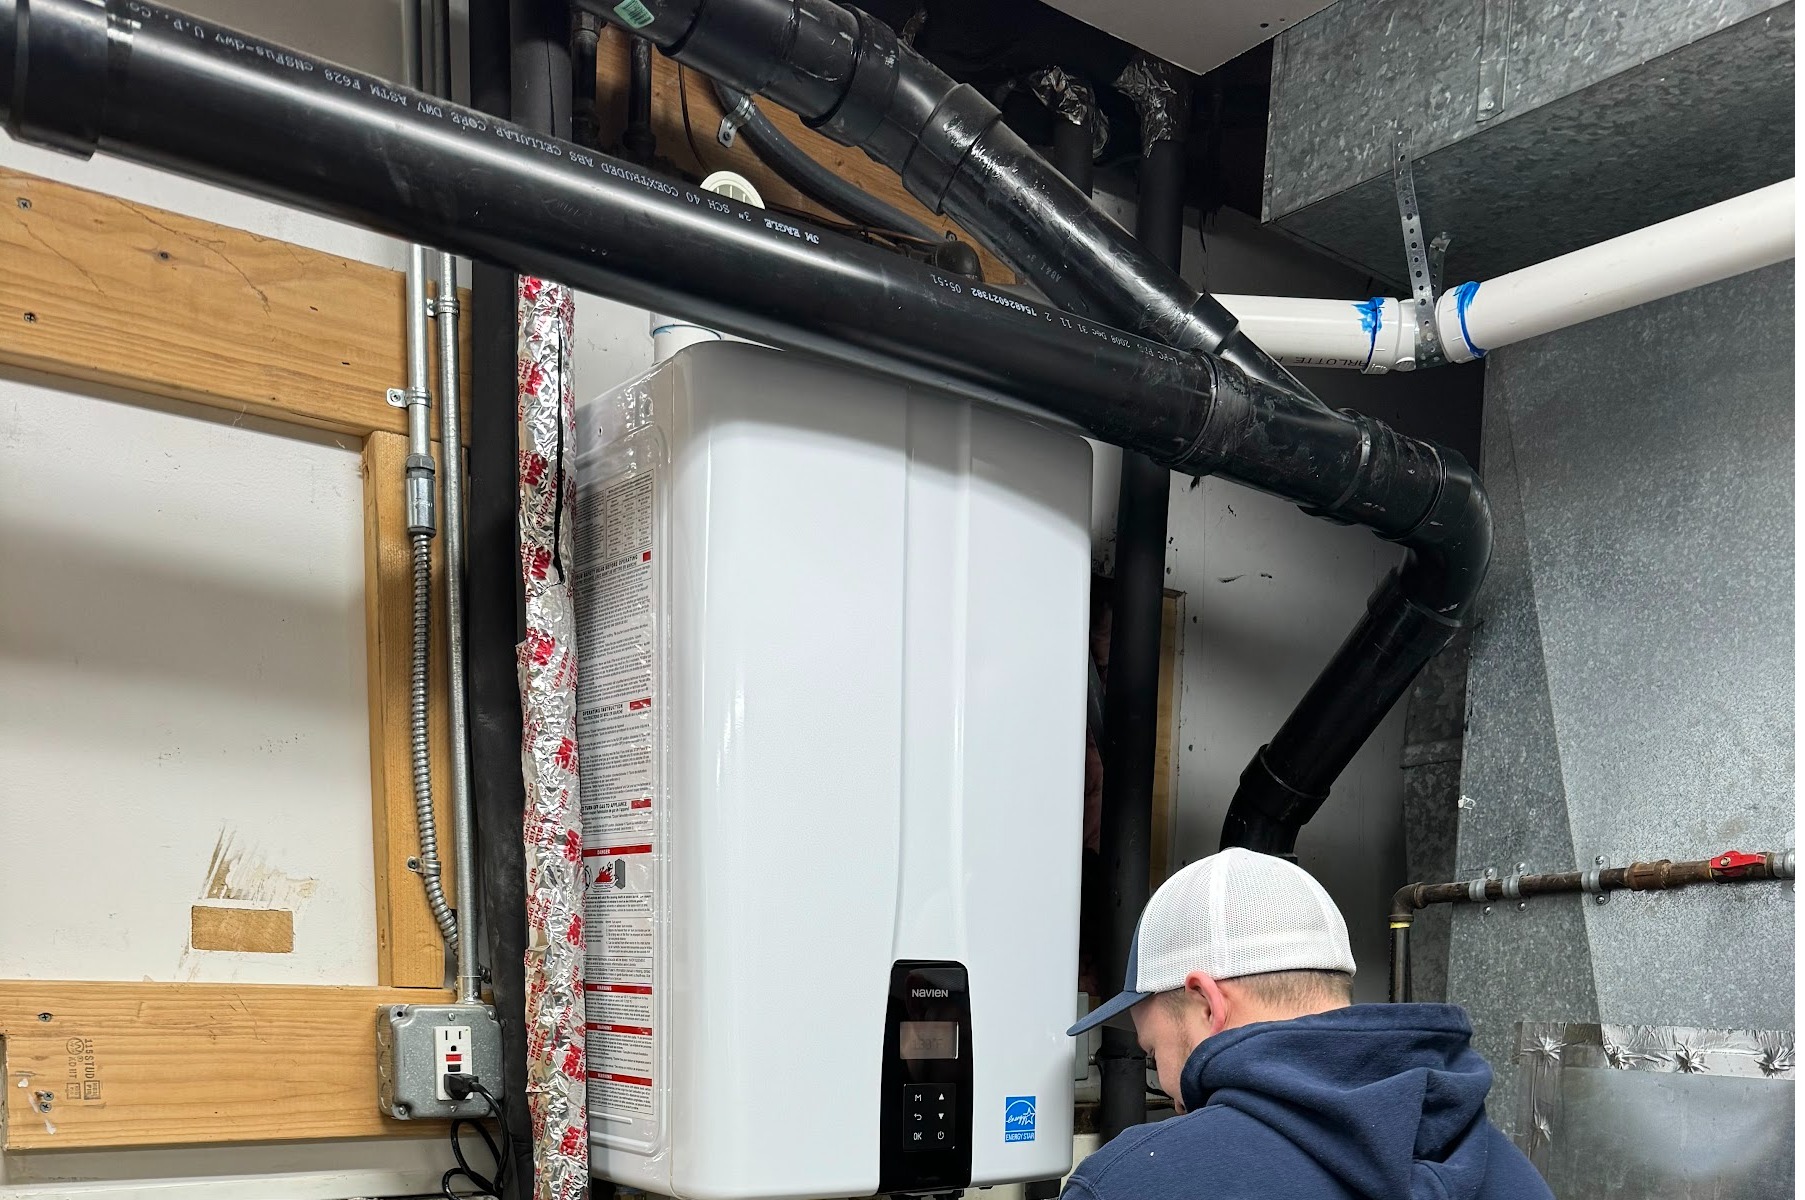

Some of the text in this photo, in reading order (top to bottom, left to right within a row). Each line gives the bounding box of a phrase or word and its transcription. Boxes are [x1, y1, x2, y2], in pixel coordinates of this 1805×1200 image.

[321, 67, 363, 91] F628
[366, 82, 410, 107] ASTM
[492, 125, 563, 156] CELLULAR
[567, 150, 595, 167] ABS
[599, 161, 680, 197] COEXTRUDED
[683, 191, 701, 204] 40
[705, 198, 731, 213] SCH
[762, 218, 801, 237] EAGLE
[802, 230, 820, 244] JM
[531, 546, 552, 580] 3M
[618, 554, 637, 565] OPERATING
[915, 1094, 922, 1102] M
[913, 1132, 922, 1141] OK
[1006, 1132, 1035, 1141] ENERGY STAR
